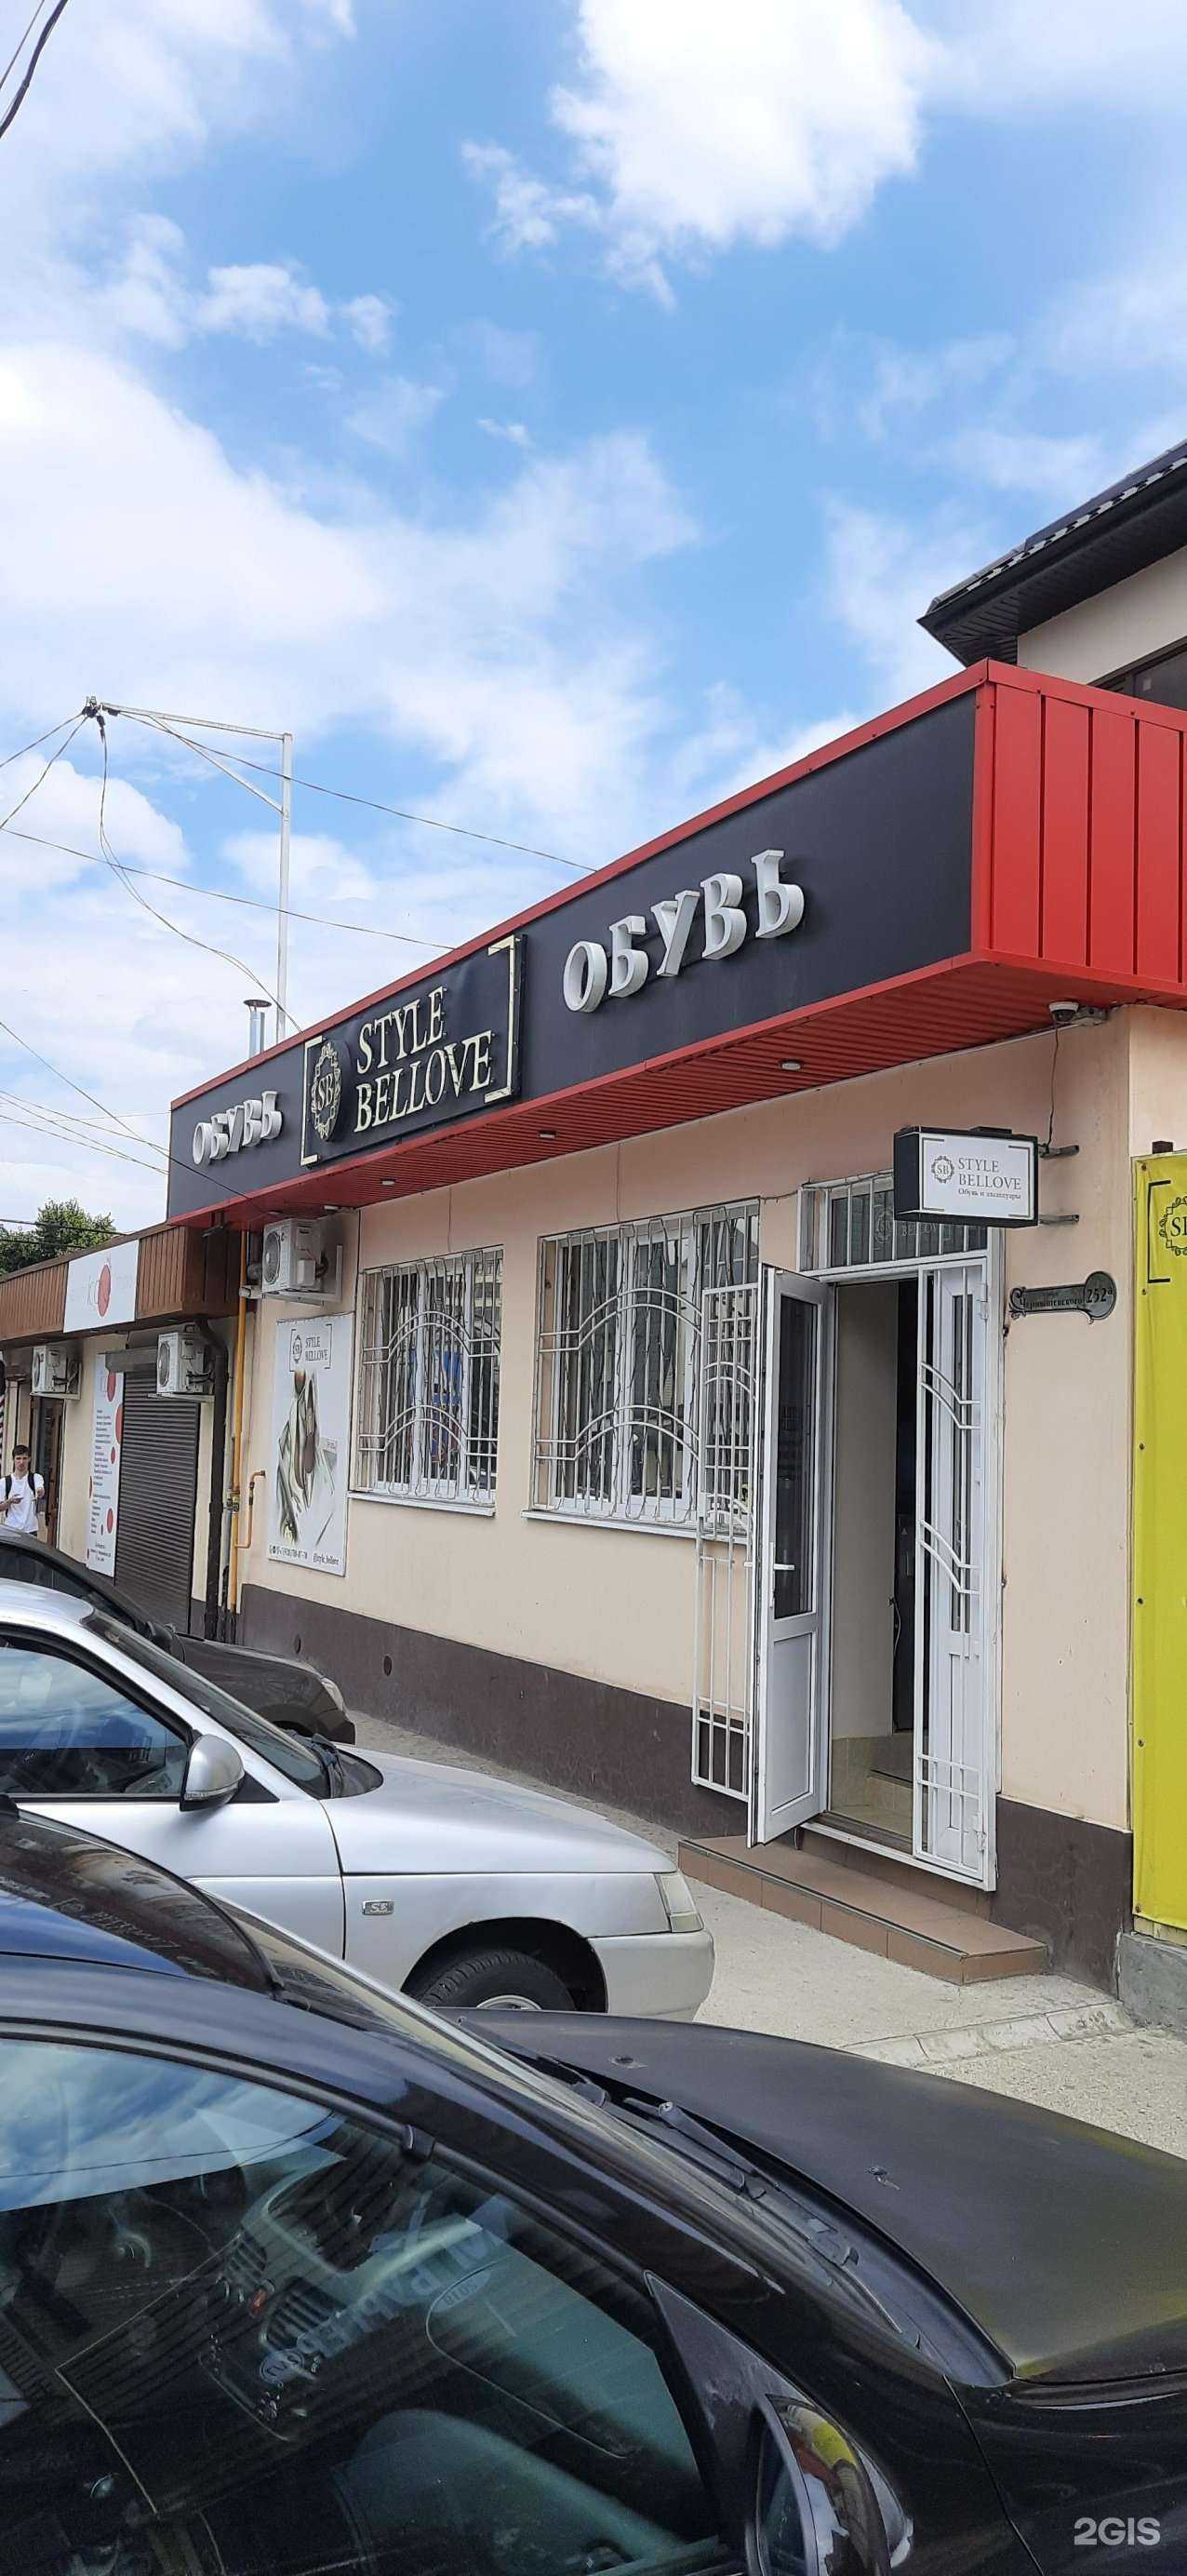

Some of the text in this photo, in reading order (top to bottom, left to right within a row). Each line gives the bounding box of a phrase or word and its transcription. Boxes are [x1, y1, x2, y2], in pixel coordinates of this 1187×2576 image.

[564, 849, 805, 1013] ОБУВЬ
[356, 986, 445, 1075] STYLE
[317, 1073, 334, 1111] SB
[353, 1029, 492, 1133] BELLOVE
[193, 1091, 283, 1164] ОБУВЬ
[937, 1164, 949, 1175] SB
[958, 1157, 1000, 1173] STYLE
[958, 1173, 1022, 1190] BELLOVE
